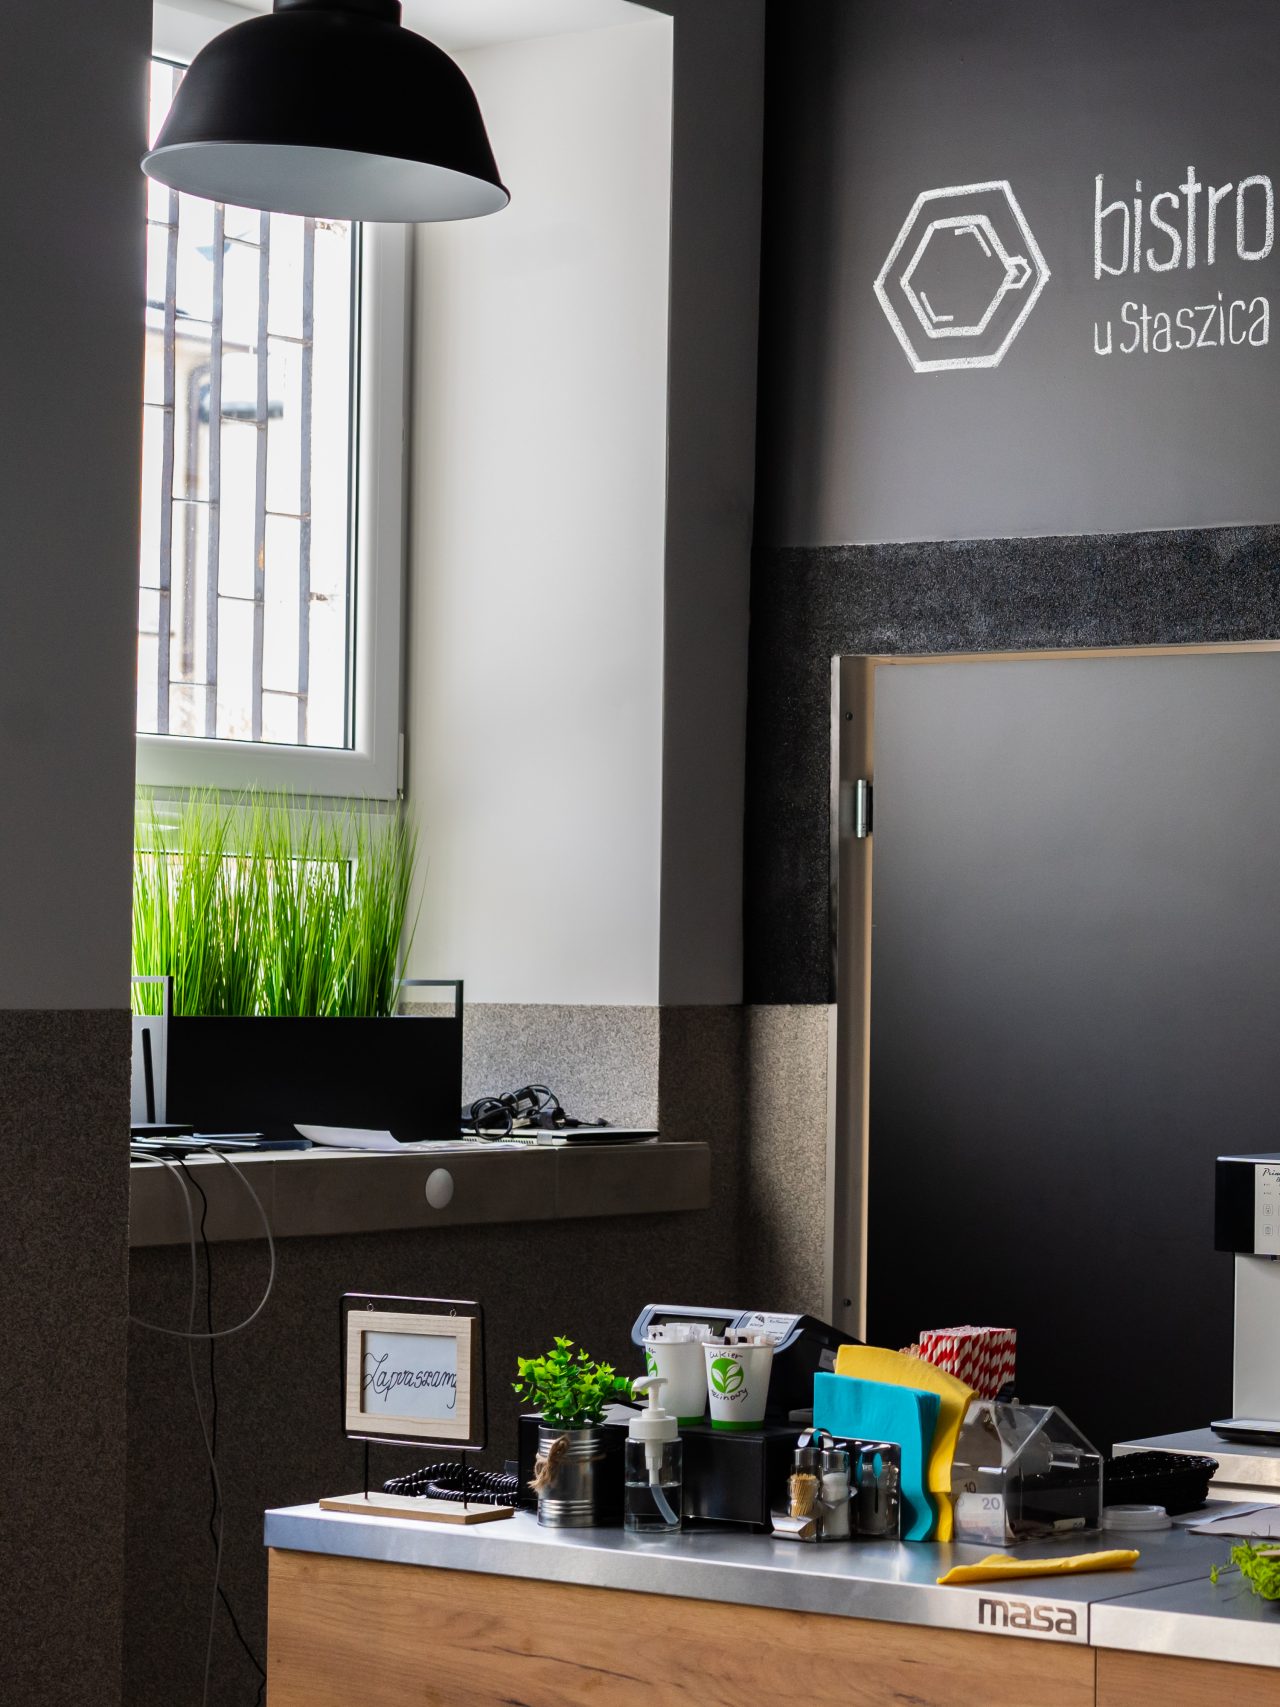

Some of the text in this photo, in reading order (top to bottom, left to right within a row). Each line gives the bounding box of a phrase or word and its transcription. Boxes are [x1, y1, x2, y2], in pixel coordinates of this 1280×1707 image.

[1094, 165, 1275, 280] bistro
[1093, 291, 1271, 355] u Staszica
[982, 1497, 1001, 1511] 20
[978, 1598, 1077, 1636] masa
